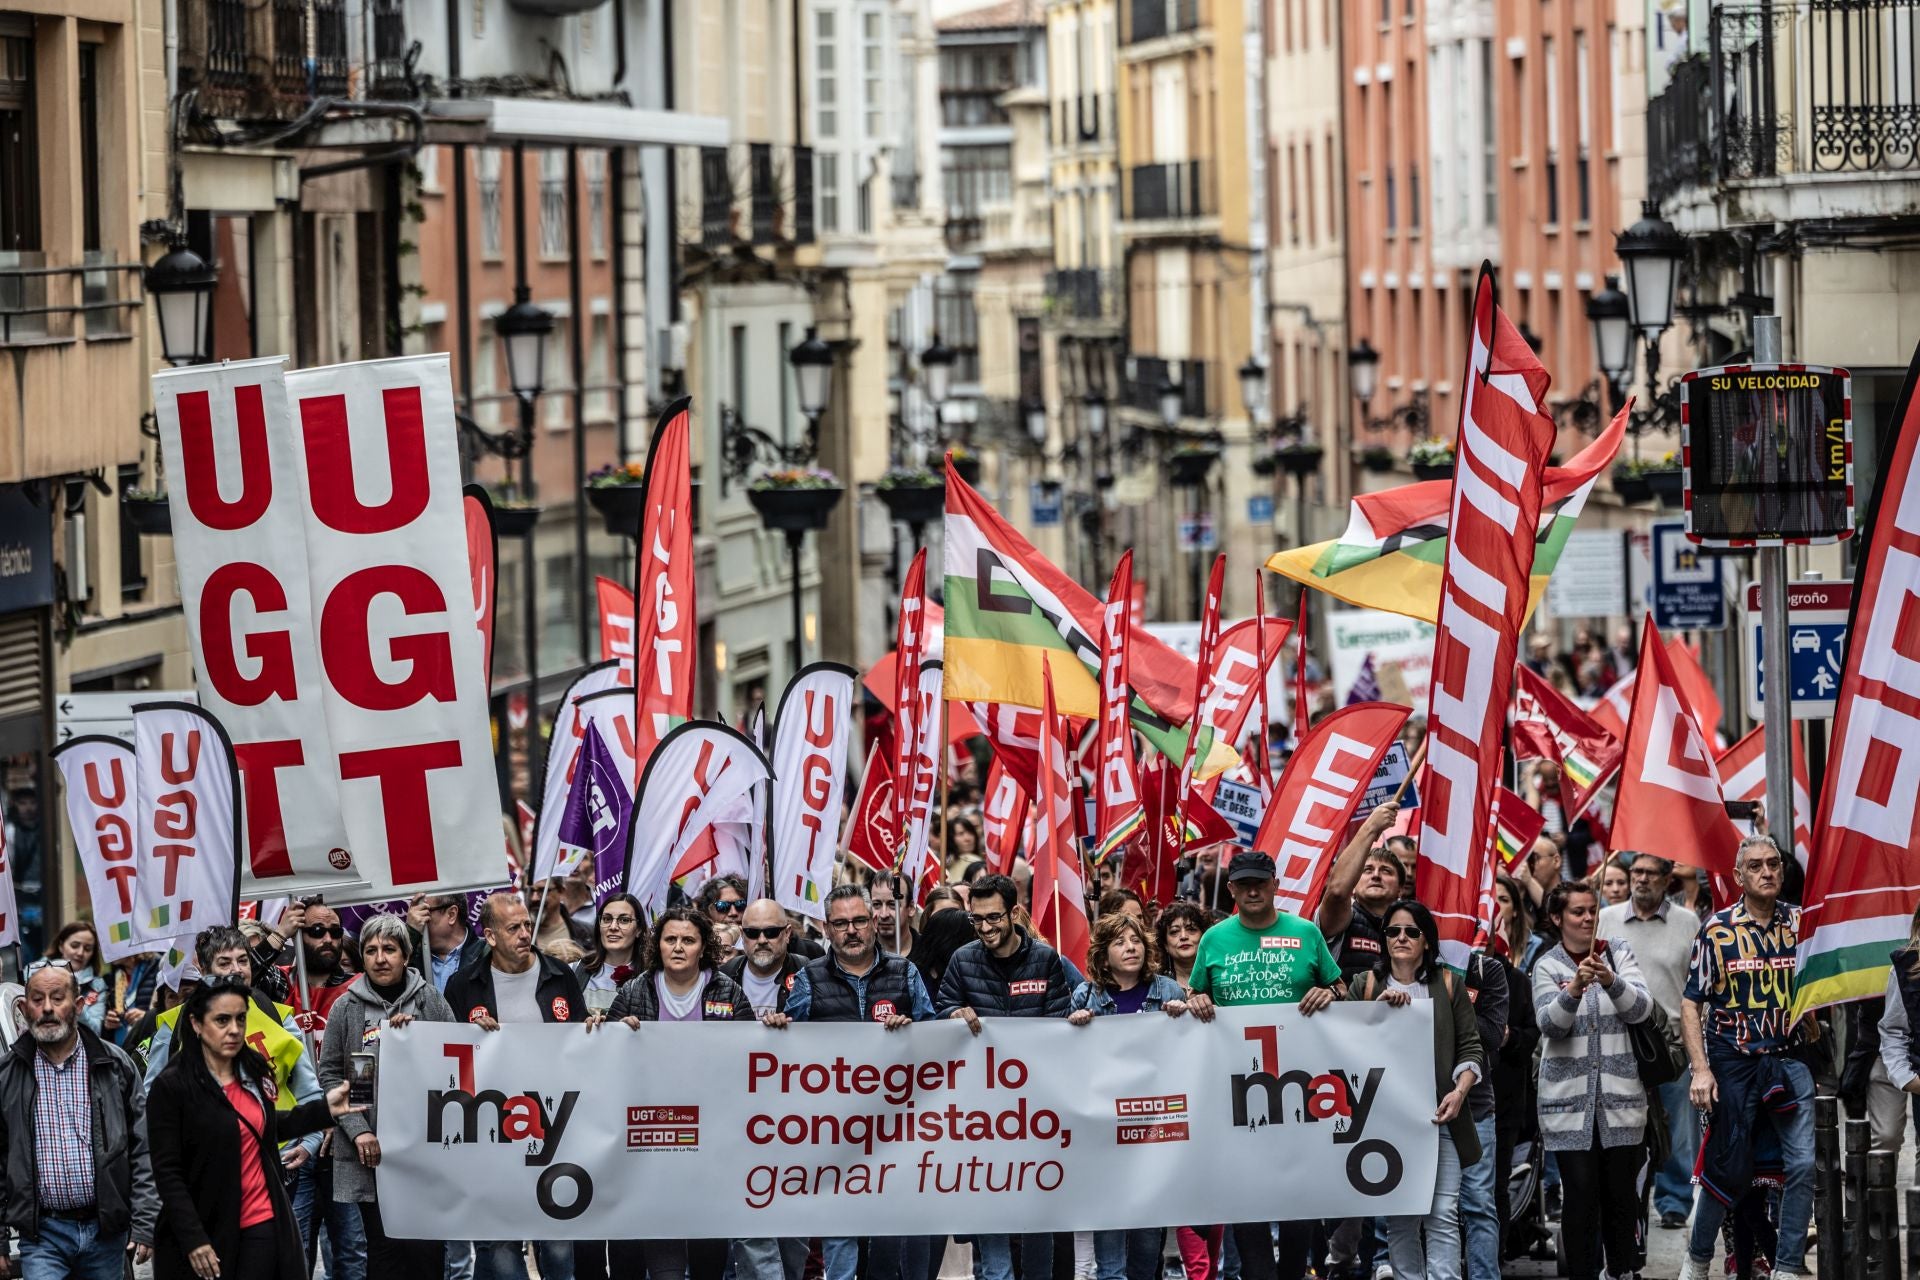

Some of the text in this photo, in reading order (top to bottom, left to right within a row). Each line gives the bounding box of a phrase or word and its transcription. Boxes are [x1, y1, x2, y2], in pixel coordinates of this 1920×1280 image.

[1711, 375, 1820, 391] SU VELOCIDAD
[1827, 418, 1846, 481] km/h
[653, 504, 683, 697] UGT
[1787, 592, 1828, 606] groño
[176, 383, 305, 880] UGT
[298, 385, 464, 887] UGT
[801, 689, 835, 871] UGT
[1261, 937, 1301, 949] CCOO
[1728, 958, 1796, 972] CCOO CCO
[1011, 982, 1047, 994] CCOO
[705, 1003, 728, 1016] UGT
[874, 1004, 893, 1015] UGT
[748, 1047, 1029, 1106] Proteger lo
[1119, 1099, 1165, 1113] CCOO
[631, 1110, 655, 1121] UGT
[746, 1098, 1071, 1155] conquistado,
[630, 1131, 676, 1144] CCOO
[1122, 1129, 1146, 1140] UGT
[745, 1151, 1064, 1209] ganar futuro
